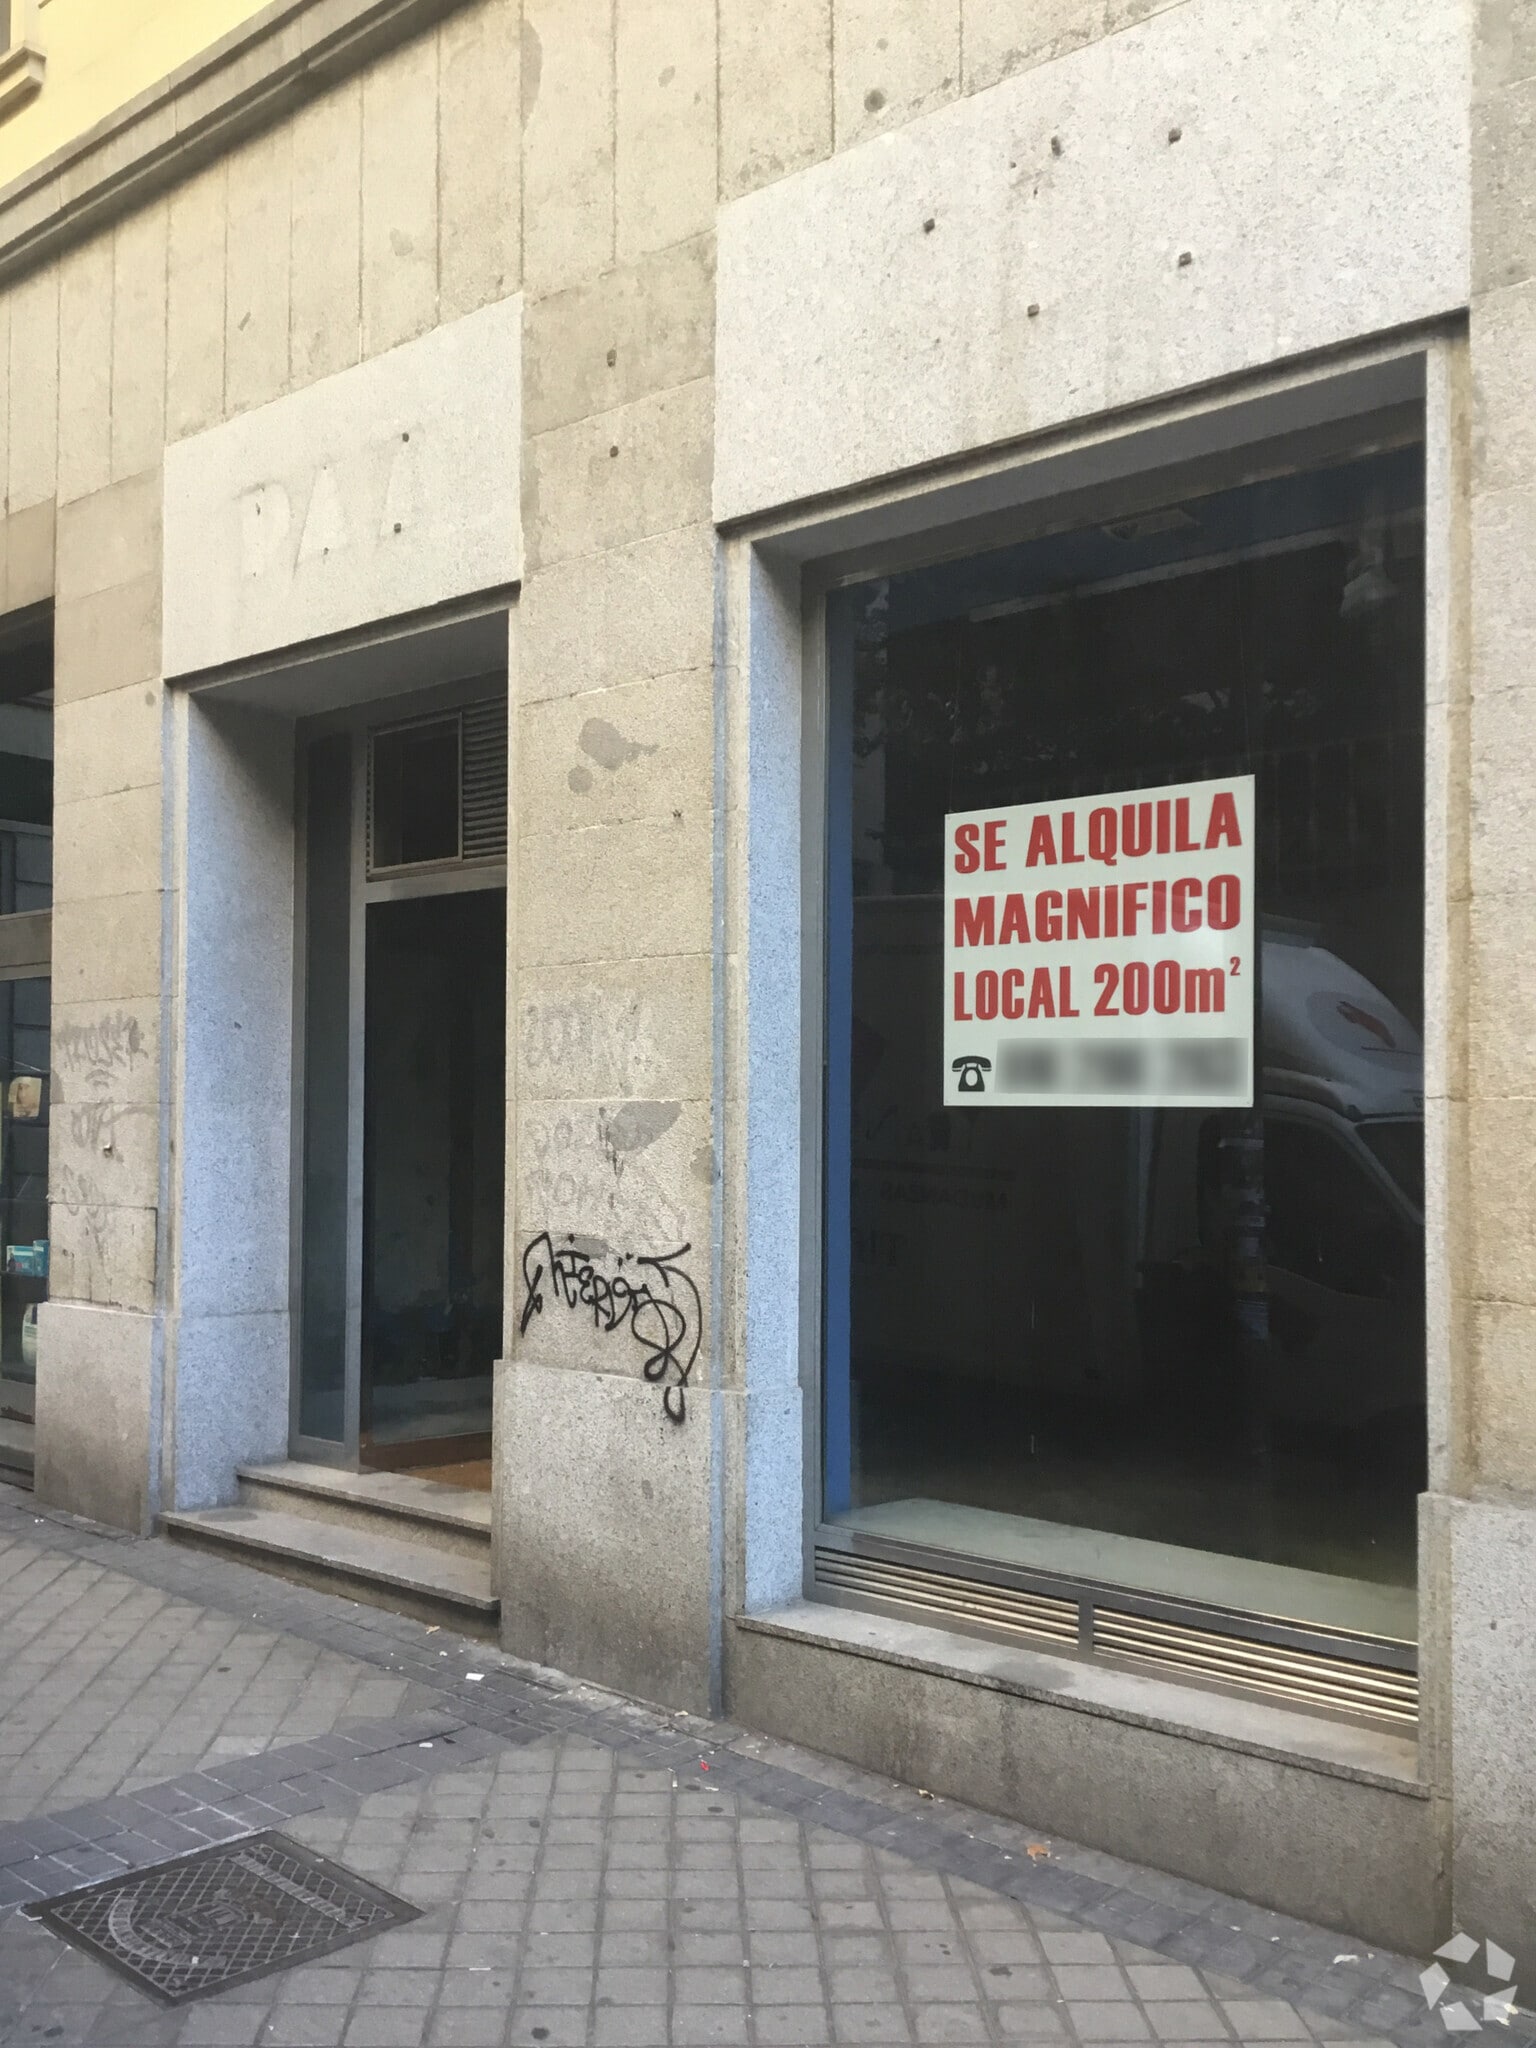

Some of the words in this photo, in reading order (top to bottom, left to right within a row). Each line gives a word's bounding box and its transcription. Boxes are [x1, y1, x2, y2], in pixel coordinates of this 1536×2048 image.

[954, 820, 1007, 874] SE
[1025, 792, 1242, 867] ALQUILA
[954, 874, 1241, 947] MAGNIFICO
[954, 966, 1080, 1021] LOCAL
